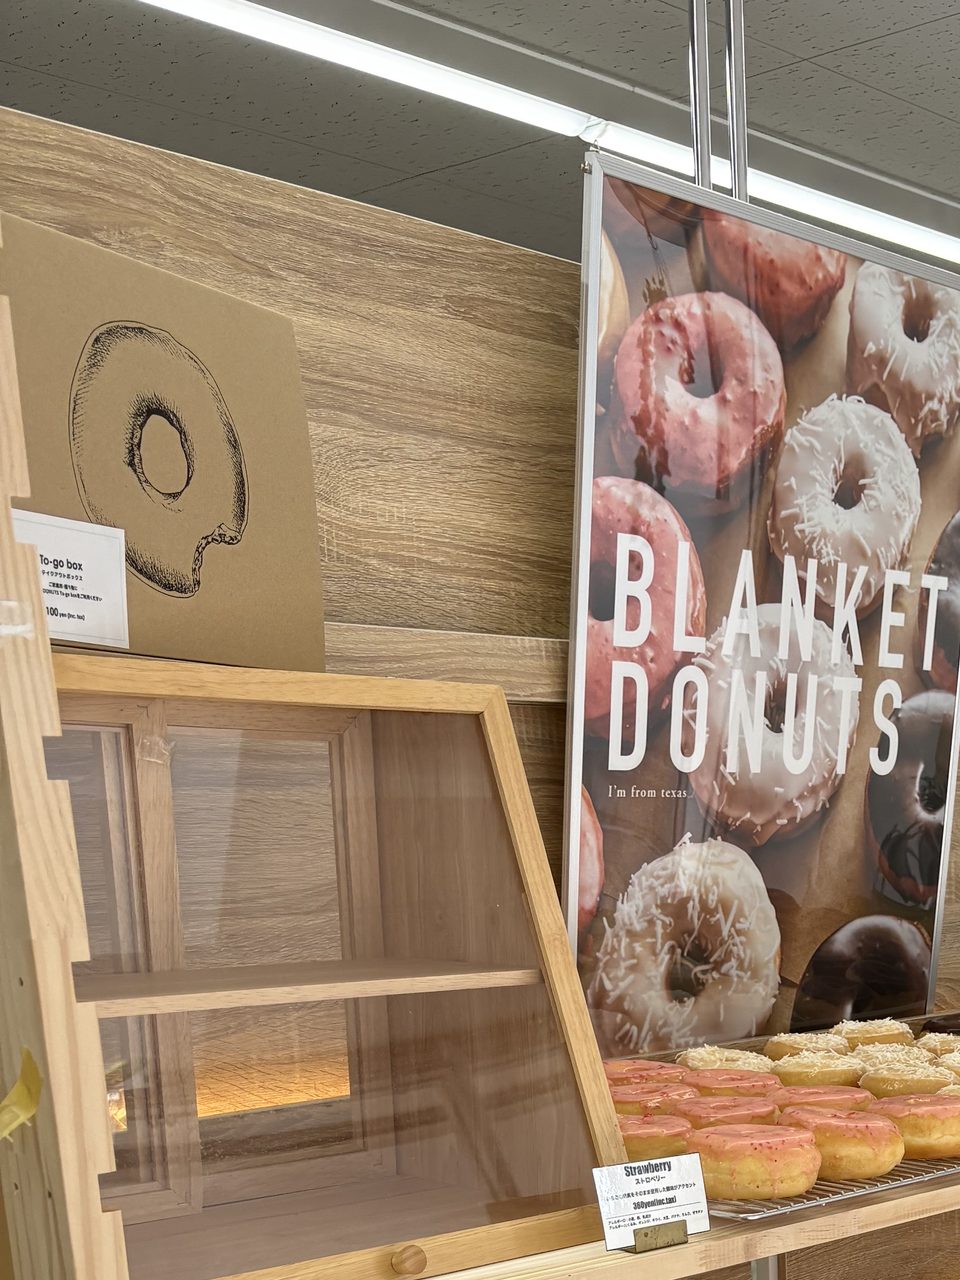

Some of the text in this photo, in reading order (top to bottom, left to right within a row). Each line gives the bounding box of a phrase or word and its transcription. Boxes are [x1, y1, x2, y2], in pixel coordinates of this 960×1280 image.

[39, 554, 84, 571] To-go box
[612, 531, 949, 671] BLANKET
[45, 606, 59, 617] 100
[607, 660, 904, 777] DONUTS
[608, 784, 687, 798] I'm from texas
[624, 1160, 672, 1177] Strawberry
[635, 1175, 666, 1185] ストロベリー
